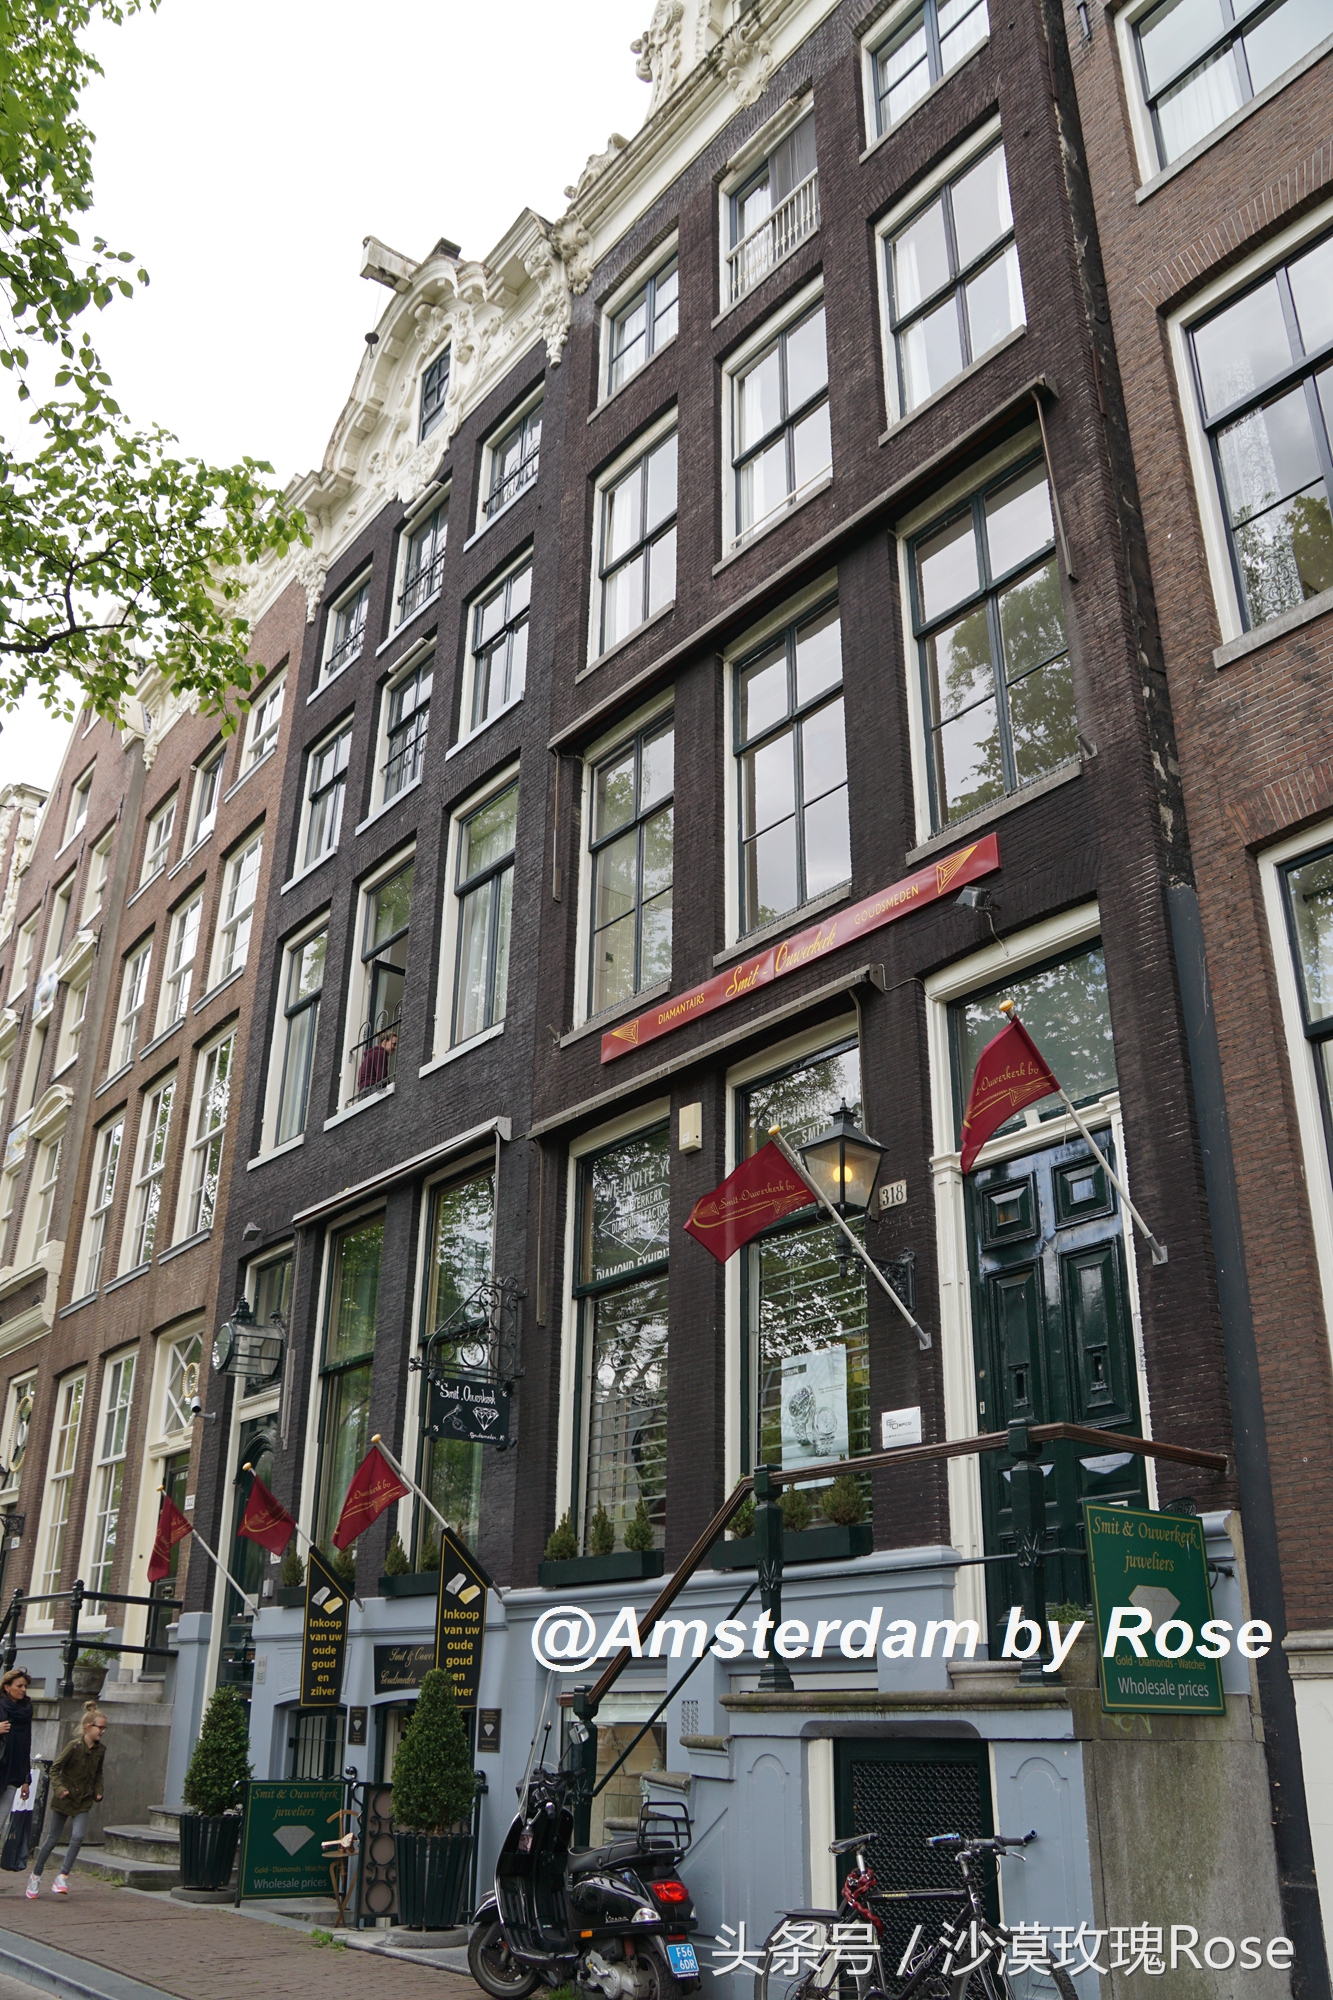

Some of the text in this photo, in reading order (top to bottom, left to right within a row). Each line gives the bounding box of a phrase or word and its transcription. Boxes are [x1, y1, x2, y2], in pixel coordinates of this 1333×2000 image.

[658, 992, 705, 1025] DIAMANTAIRS
[725, 966, 758, 998] Smit
[774, 922, 838, 972] Ouwerkerk
[854, 884, 920, 926] GOUDSMEDEN
[623, 1165, 655, 1193] INVITE
[882, 1184, 904, 1206] 318
[645, 1202, 670, 1224] FACTOR
[596, 1247, 670, 1281] DIAMOND EXHIBIT
[440, 1382, 460, 1400] Smit
[1092, 1516, 1200, 1550] Smit & Ouwerkerk
[1124, 1550, 1174, 1574] juweliers
[444, 1609, 480, 1621] Inkoop
[310, 1618, 342, 1630] Inkoop
[444, 1626, 480, 1634] van uw
[312, 1645, 336, 1655] oude
[446, 1640, 474, 1650] oude
[311, 1658, 336, 1670] goud
[404, 1649, 413, 1668] &
[446, 1655, 473, 1668] goud
[1114, 1654, 1134, 1666] Gold
[1138, 1656, 1173, 1669] Diamonds
[1178, 1658, 1206, 1670] Watches
[318, 1674, 329, 1682] en
[452, 1672, 466, 1681] en
[310, 1687, 336, 1696] zilver
[452, 1685, 474, 1696] lver
[1118, 1676, 1210, 1700] Wholesale prices
[252, 1787, 341, 1801] Smit & Ouwerkerk
[272, 1804, 316, 1820] juweliers
[254, 1866, 268, 1874] Gold
[254, 1877, 328, 1890] Wholesale prices
[676, 1946, 692, 1958] F56
[680, 1959, 696, 1970] 6DR
